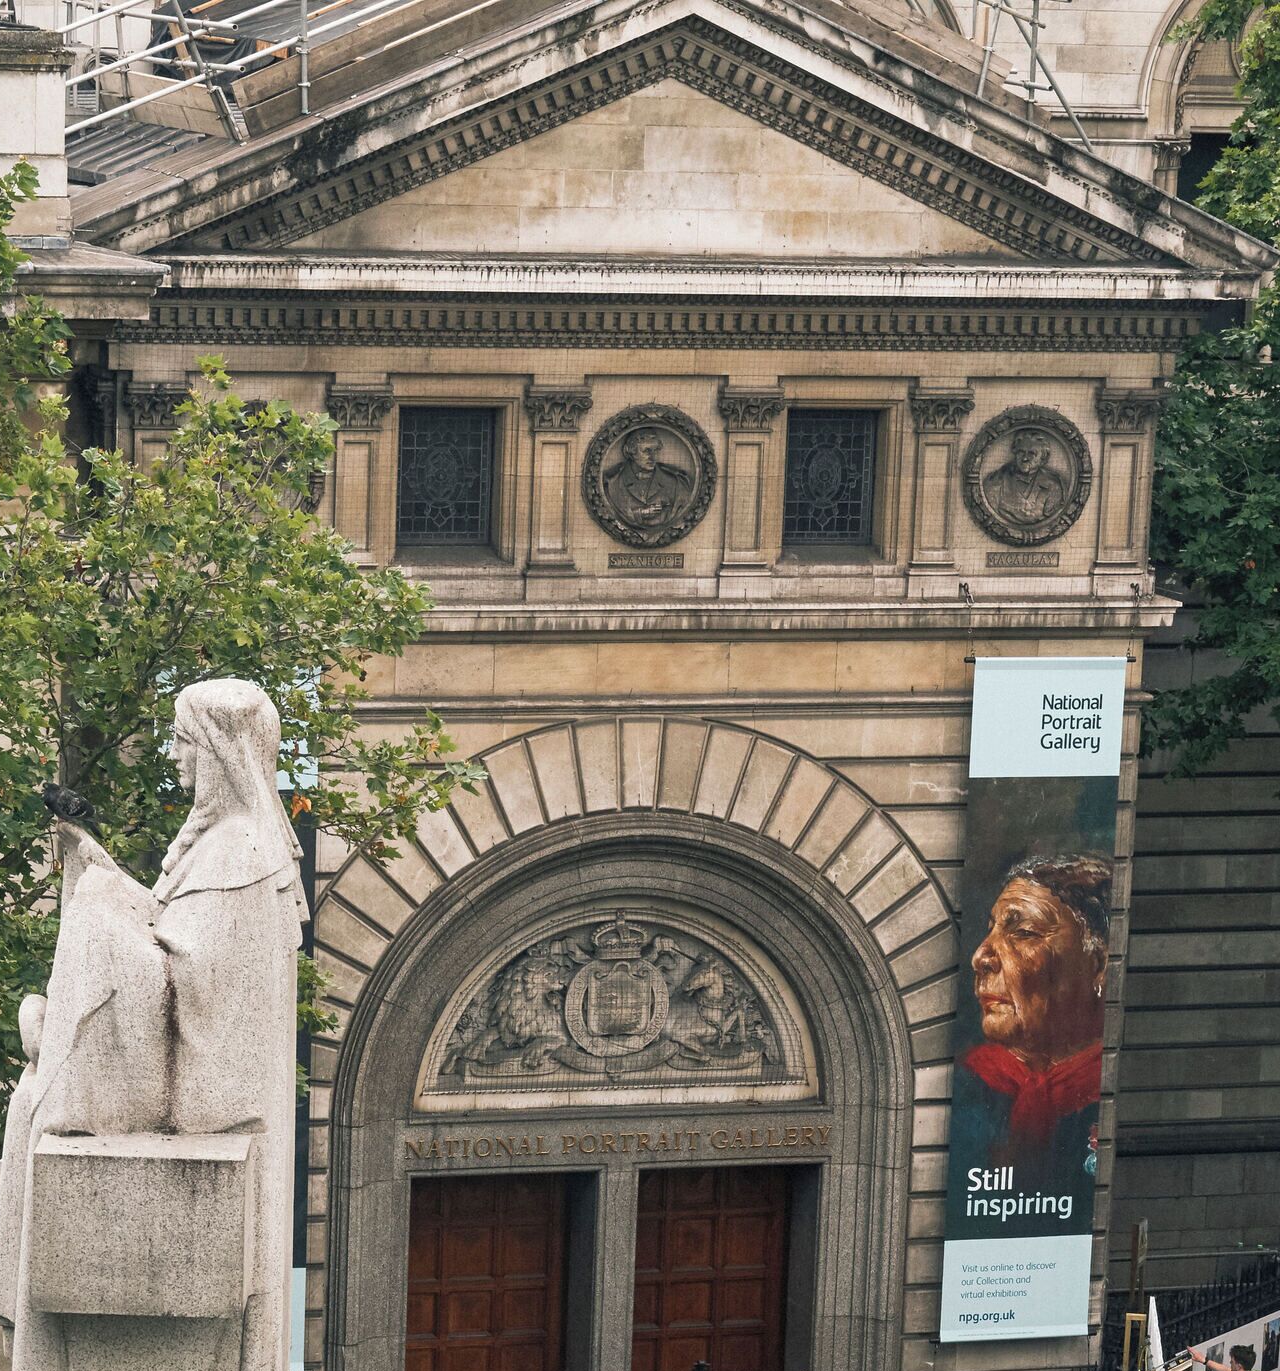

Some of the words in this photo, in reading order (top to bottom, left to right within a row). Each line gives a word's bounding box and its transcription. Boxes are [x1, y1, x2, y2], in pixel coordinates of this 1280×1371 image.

[610, 555, 682, 567] STANHOPE
[988, 553, 1056, 566] MACAULAY
[1042, 694, 1103, 710] National
[1041, 713, 1102, 730] Portrait
[1040, 733, 1101, 753] Gallery
[404, 1135, 552, 1161] NATIONAL
[561, 1128, 701, 1154] PORTRAIT
[710, 1124, 834, 1149] GALLERY
[967, 1166, 1014, 1192] Still
[966, 1192, 1073, 1222] inspiring
[962, 1264, 978, 1272] Visit
[990, 1263, 1014, 1272] online
[1016, 1263, 1024, 1271] to
[1026, 1262, 1056, 1271] discover
[976, 1276, 1014, 1285] Collection
[1015, 1275, 1031, 1284] and
[960, 1290, 985, 1299] virtual
[986, 1288, 1028, 1298] exhibitions
[959, 1309, 1015, 1324] npg.org.uk
